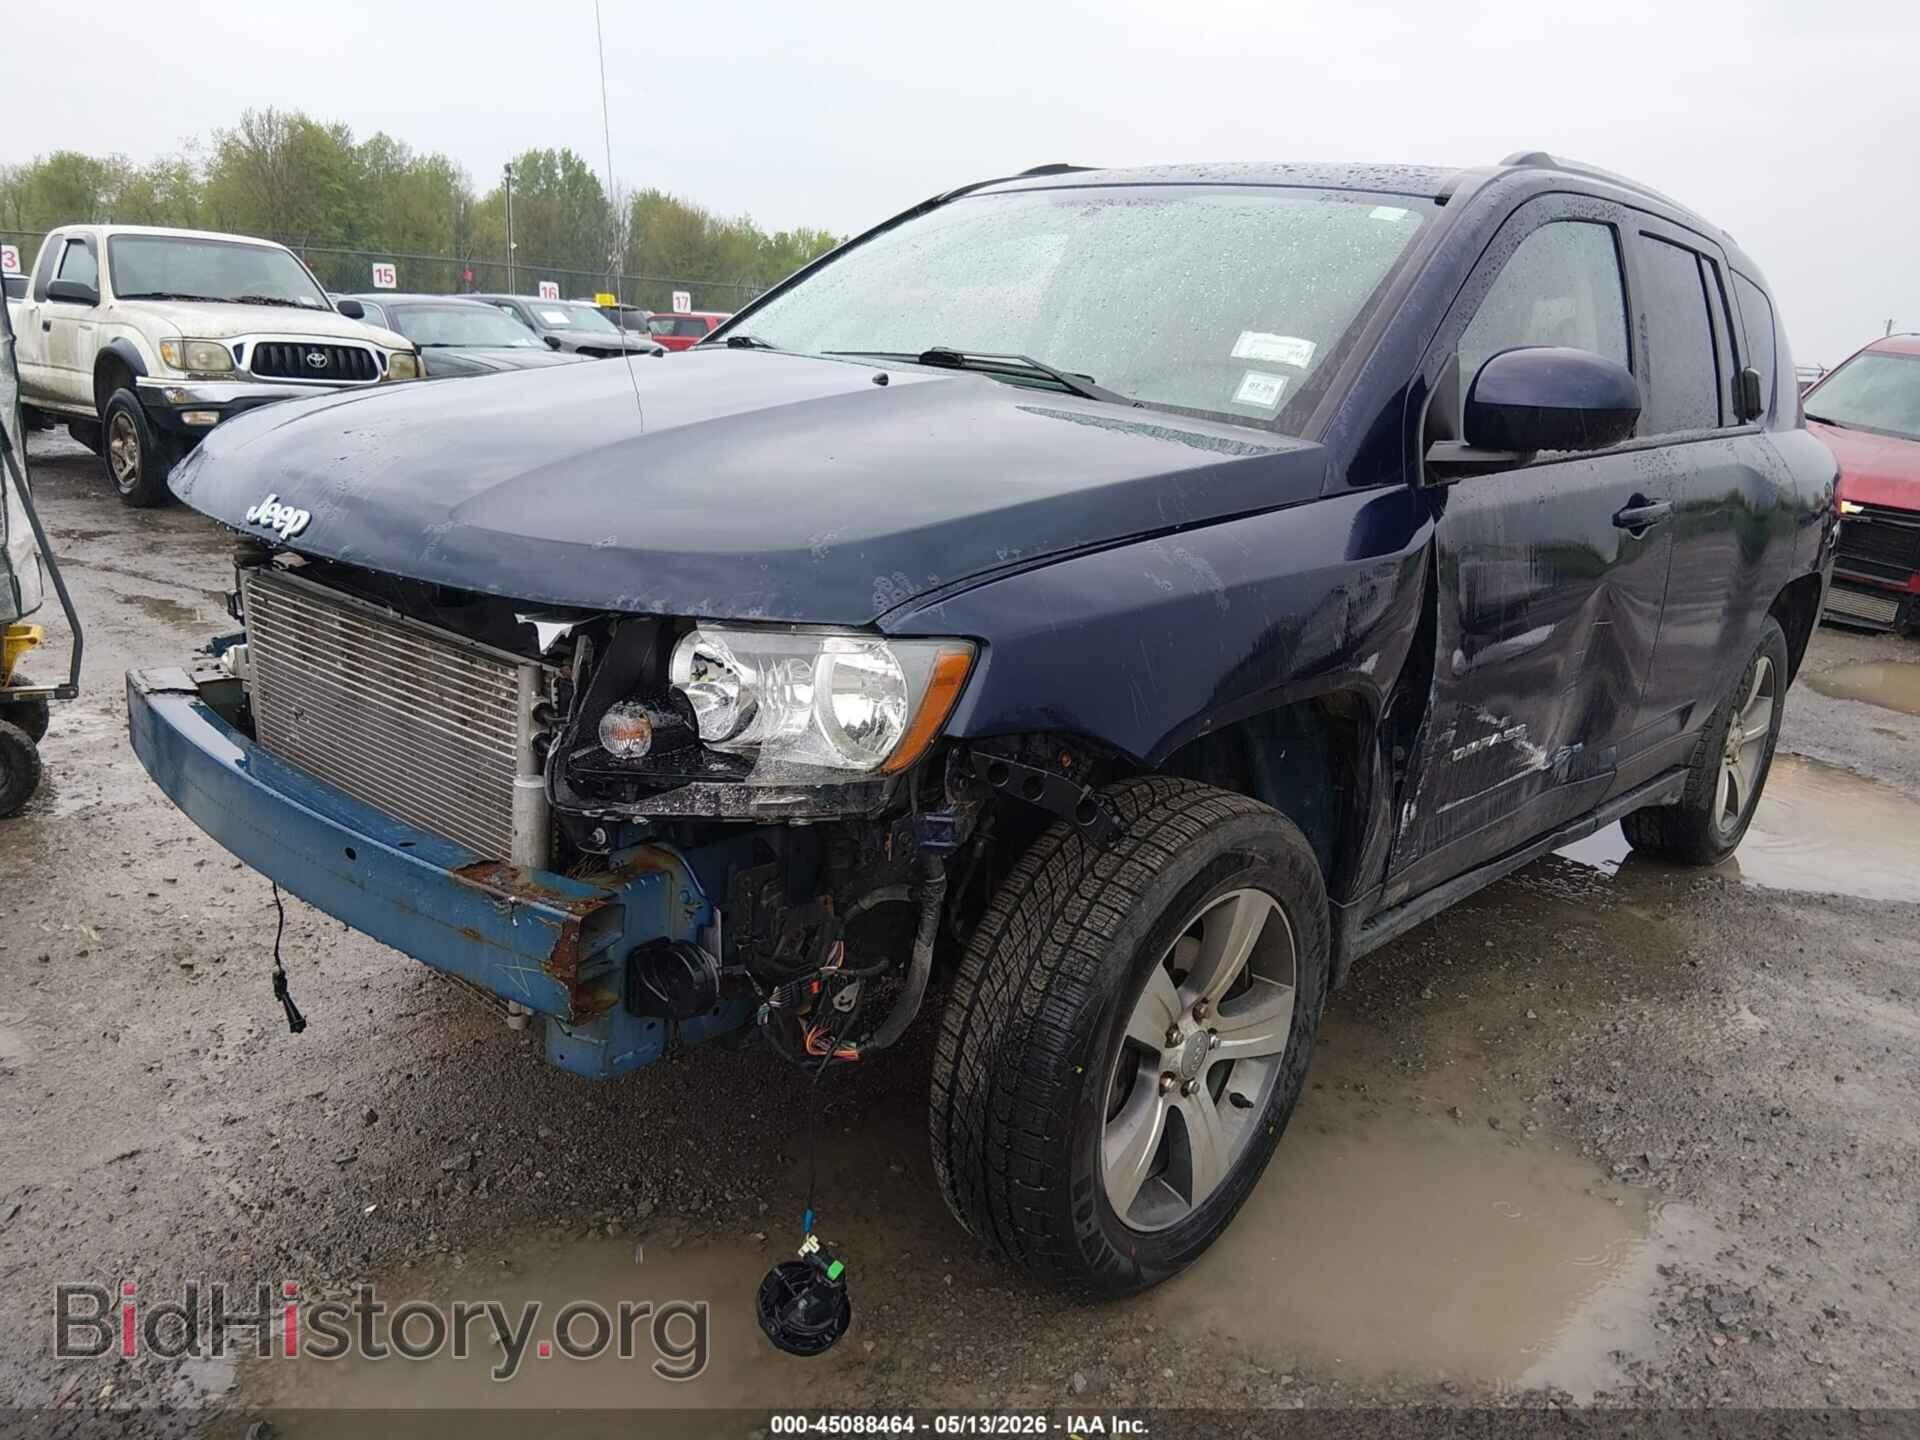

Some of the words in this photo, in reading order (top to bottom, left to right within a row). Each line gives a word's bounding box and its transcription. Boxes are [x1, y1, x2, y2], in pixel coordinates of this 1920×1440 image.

[375, 268, 394, 284] 15
[541, 286, 558, 300] 16
[675, 296, 689, 310] 17
[245, 493, 311, 540] Jeep
